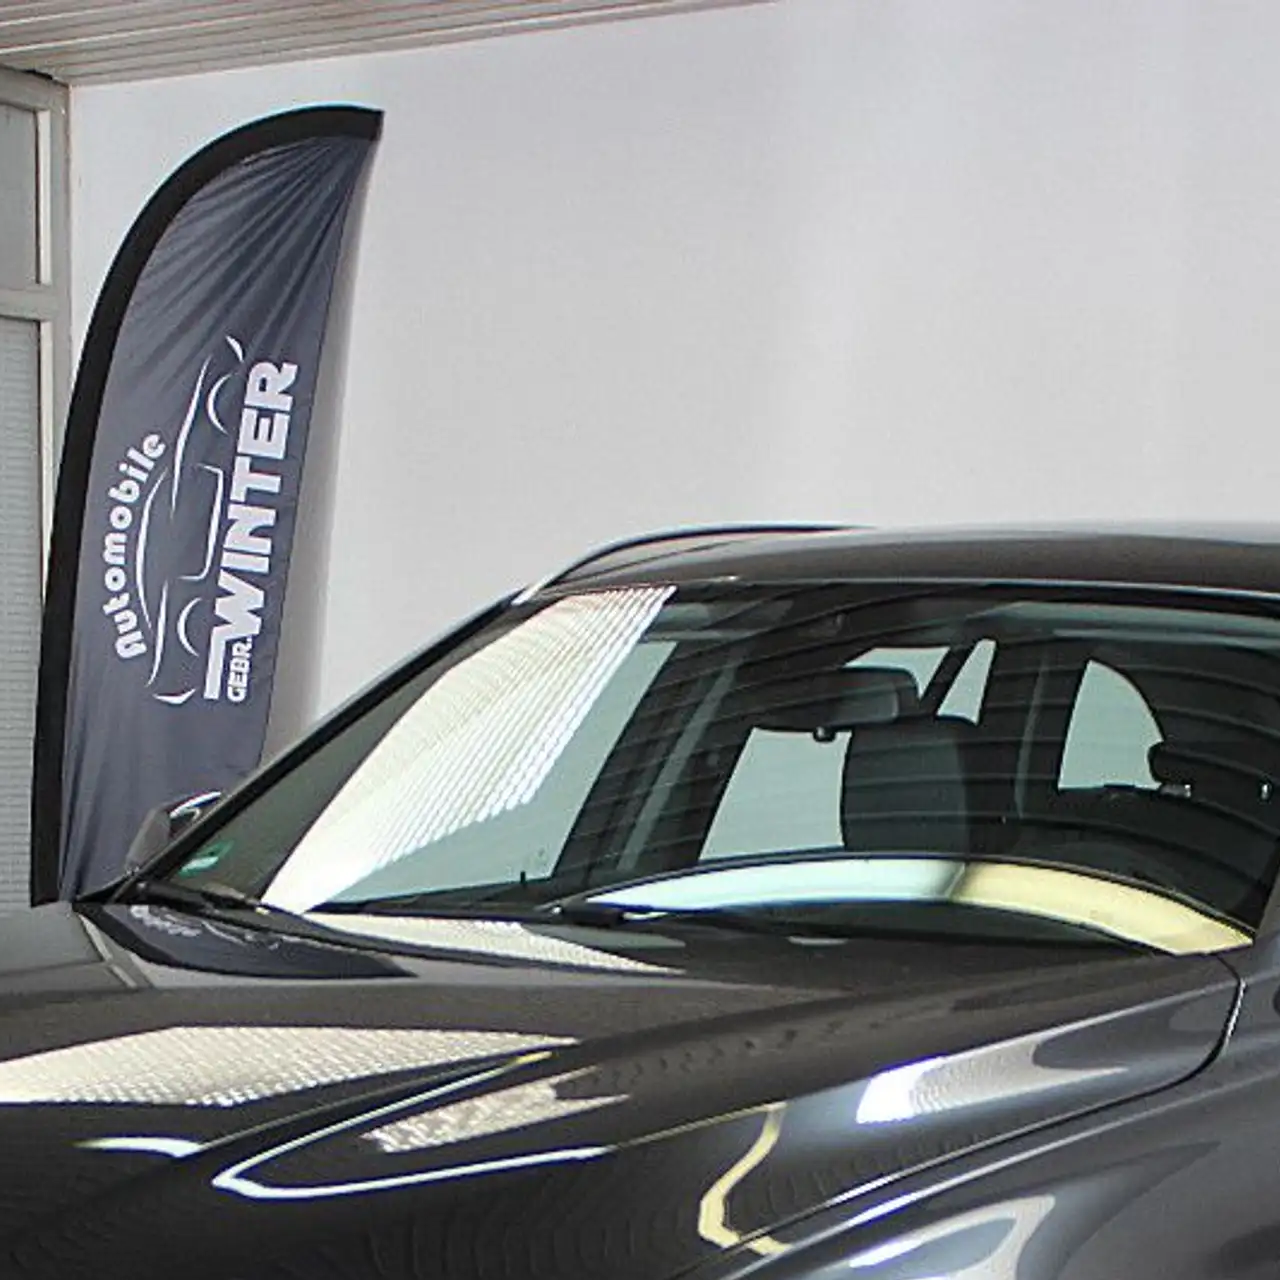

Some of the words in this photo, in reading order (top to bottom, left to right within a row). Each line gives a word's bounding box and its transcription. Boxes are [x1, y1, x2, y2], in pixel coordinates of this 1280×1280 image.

[102, 431, 167, 660] Automobile
[214, 361, 299, 643] WINTER
[227, 636, 253, 703] GEBR.
